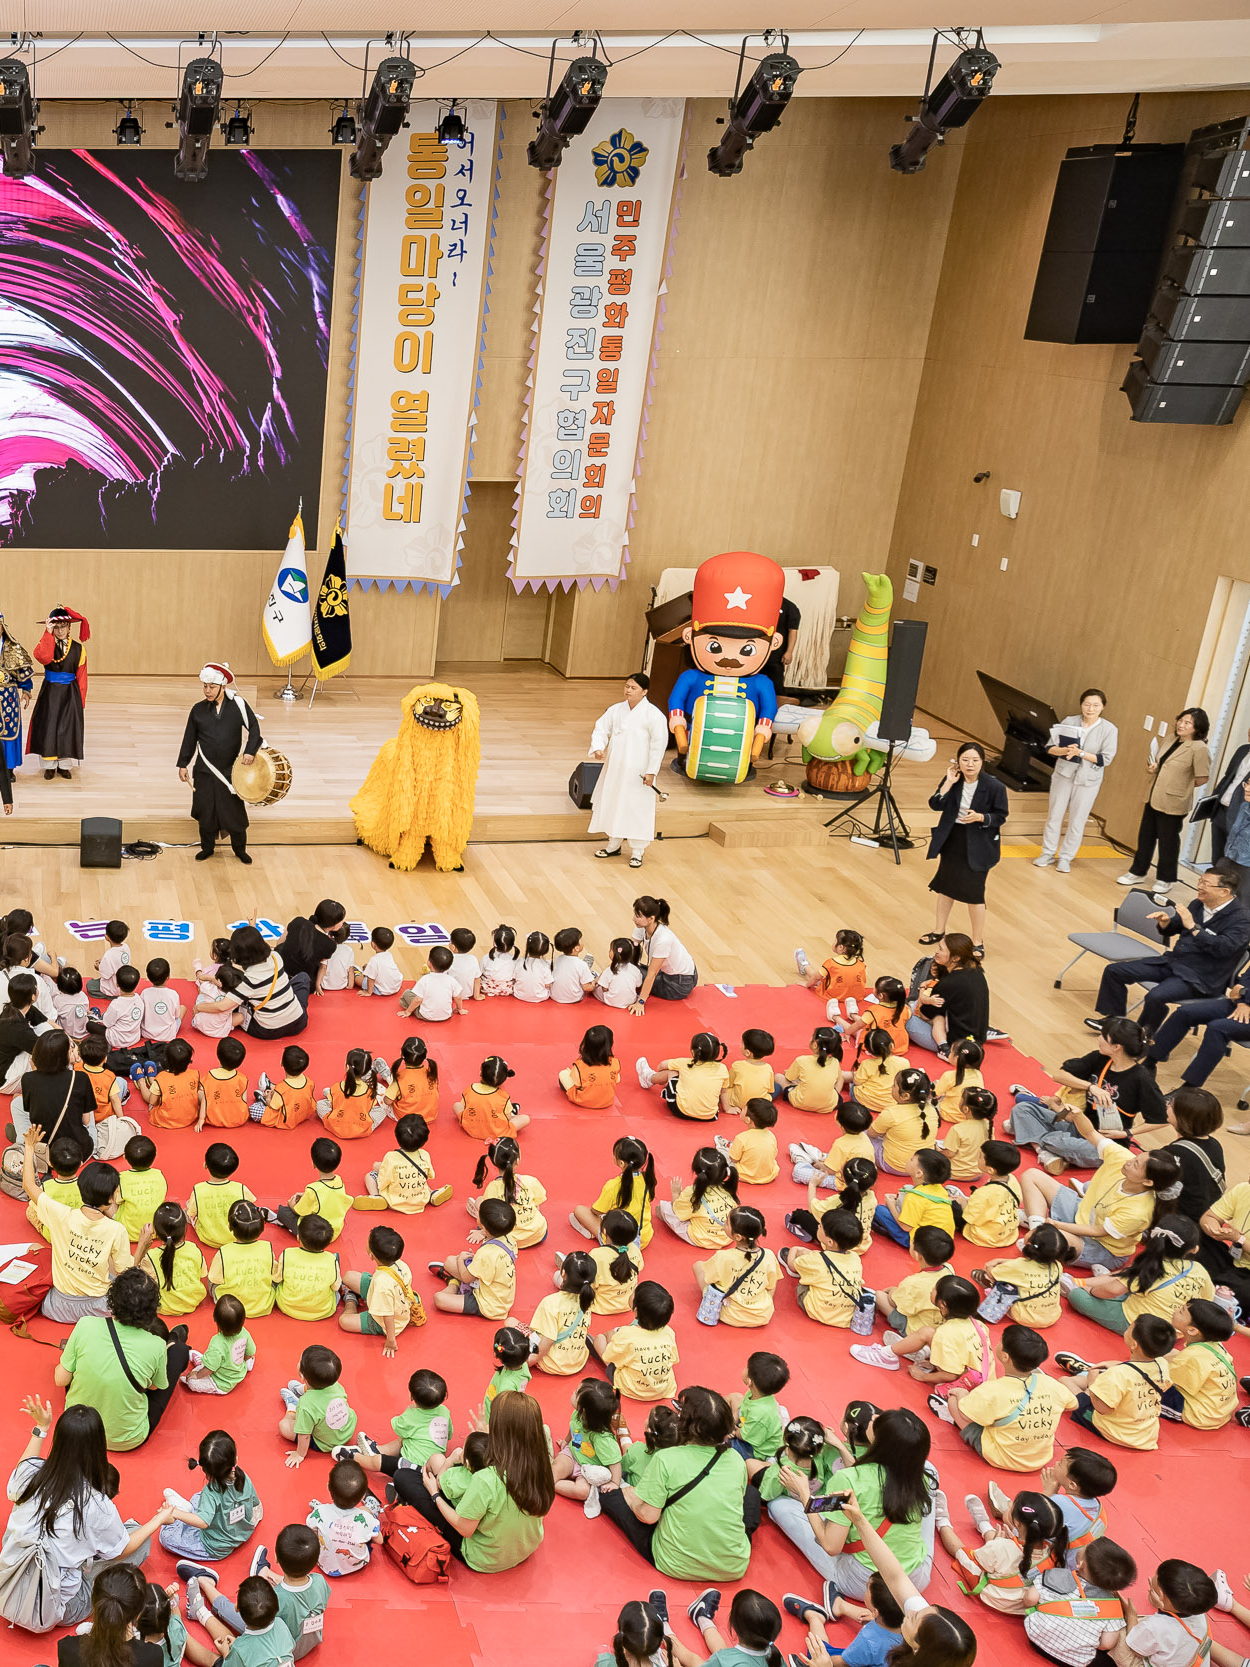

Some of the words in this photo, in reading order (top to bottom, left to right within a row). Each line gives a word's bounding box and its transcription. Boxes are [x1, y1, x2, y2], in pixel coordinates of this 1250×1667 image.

[392, 131, 450, 375] 통일마당이
[545, 199, 613, 520] 서울광진구협의회
[578, 199, 643, 520] 민주평화통일자문회의
[381, 389, 430, 524] 열렸네
[399, 1180, 427, 1190] Vicky
[68, 1250, 99, 1268] Vicky
[70, 1239, 102, 1259] Lucky
[1137, 1400, 1161, 1411] Vick
[1018, 1419, 1053, 1430] Vicky
